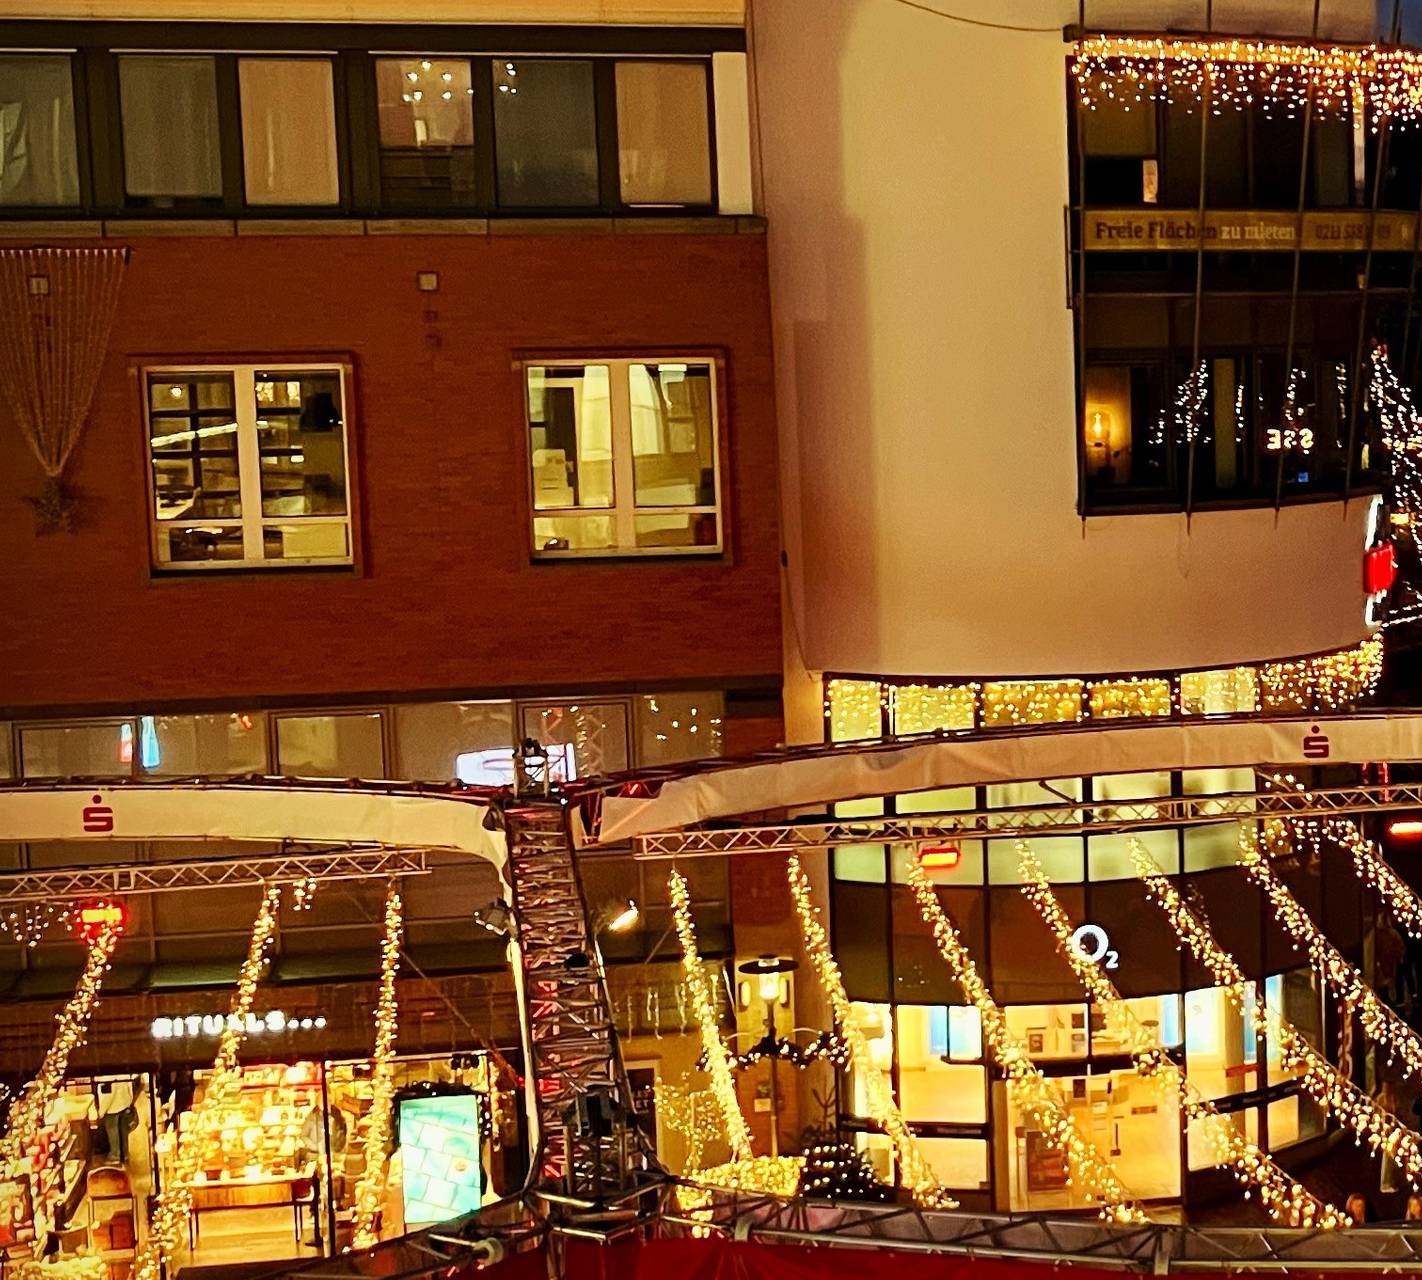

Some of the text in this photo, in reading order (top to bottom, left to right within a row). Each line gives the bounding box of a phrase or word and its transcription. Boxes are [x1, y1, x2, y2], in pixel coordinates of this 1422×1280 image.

[1096, 221, 1143, 239] Freie
[1148, 220, 1217, 239] Flächn
[1221, 225, 1241, 240] zu
[1244, 220, 1295, 241] mieten
